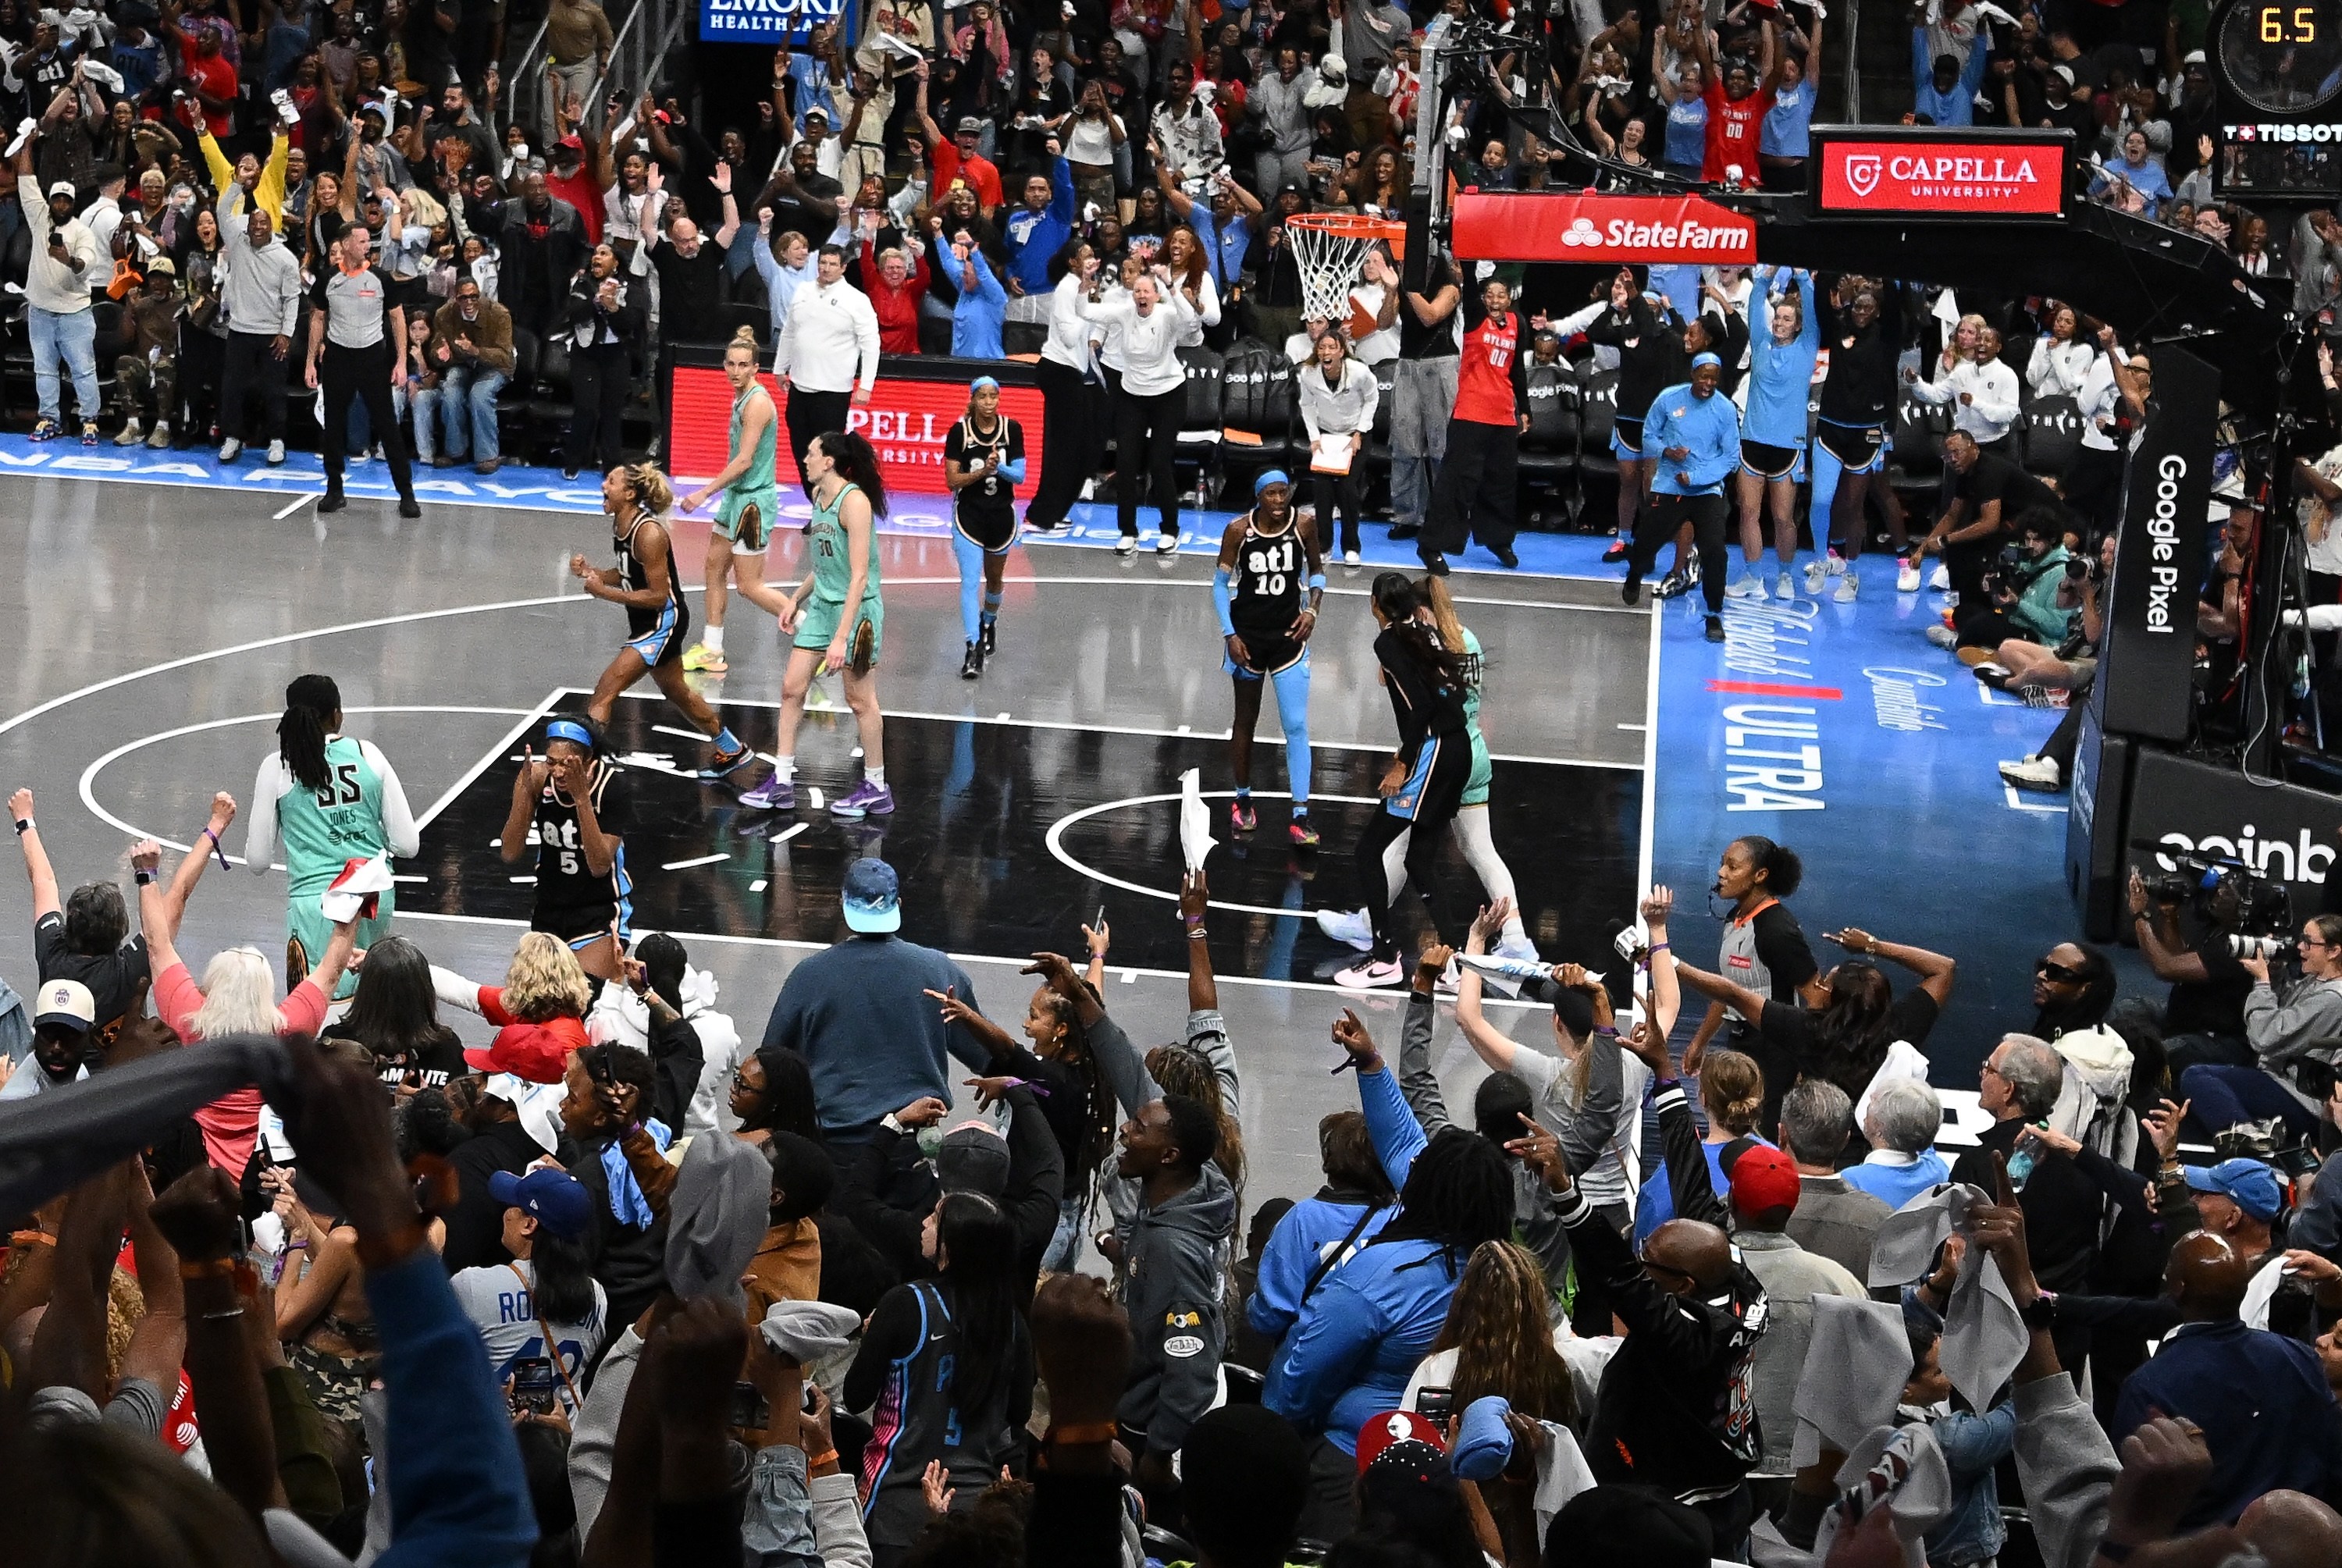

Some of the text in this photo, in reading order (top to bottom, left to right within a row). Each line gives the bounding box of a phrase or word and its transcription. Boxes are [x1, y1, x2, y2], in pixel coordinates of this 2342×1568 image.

[710, 14, 826, 33] HEALTHA
[2261, 7, 2315, 43] 6.5
[2257, 123, 2342, 142] TISSOT
[1889, 156, 2037, 183] CAPELLA
[1528, 388, 1554, 399] ogle
[845, 409, 947, 443] PELL
[882, 448, 946, 466] RSITY
[984, 477, 998, 496] 3
[2147, 454, 2187, 633] Google Pixel
[1249, 542, 1294, 573] atl
[1254, 574, 1287, 596] 10
[1723, 704, 1826, 812] ULTRA
[543, 819, 585, 850] at
[561, 851, 578, 875] 5
[2155, 823, 2337, 884] coinb
[377, 1067, 405, 1083] AM
